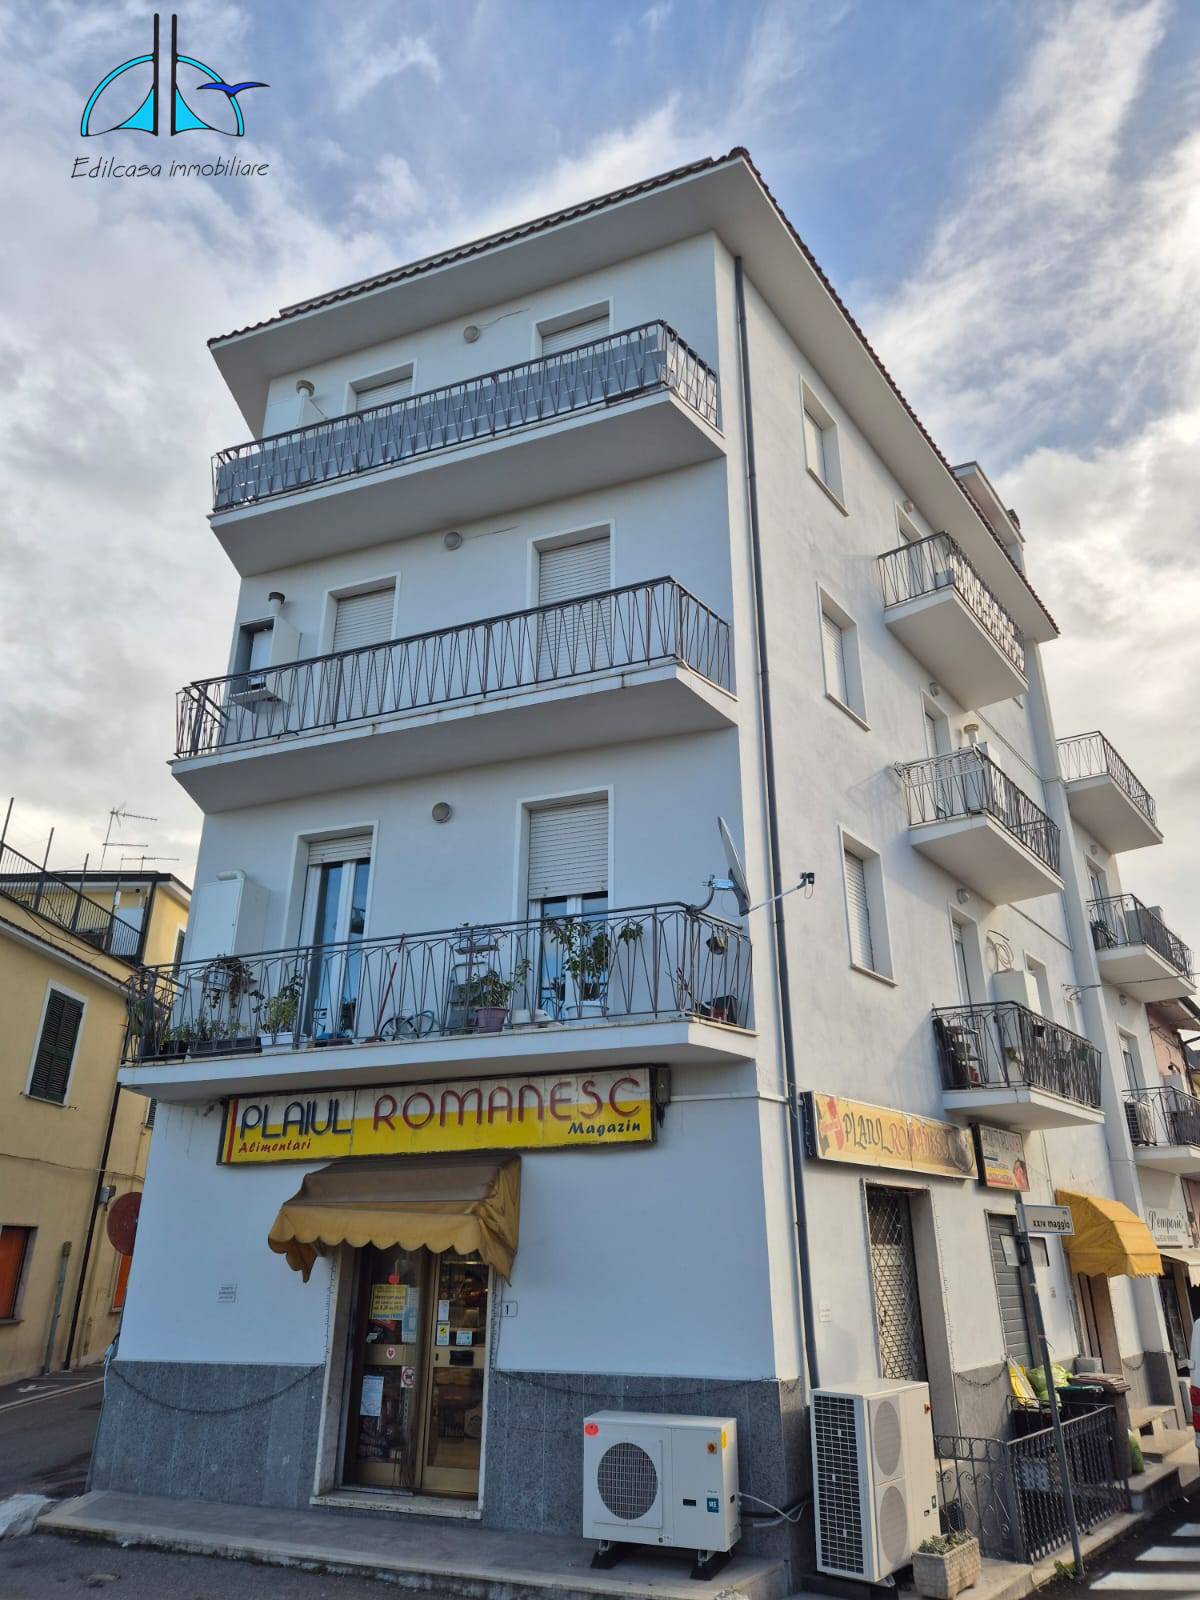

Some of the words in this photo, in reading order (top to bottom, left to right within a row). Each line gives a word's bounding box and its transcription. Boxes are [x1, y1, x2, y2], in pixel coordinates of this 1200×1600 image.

[239, 1098, 352, 1139] PLAIUL
[373, 1077, 642, 1132] ROMANESC
[567, 1119, 641, 1136] Magazin
[238, 1139, 311, 1154] Alimentari
[1047, 1219, 1070, 1230] maggio
